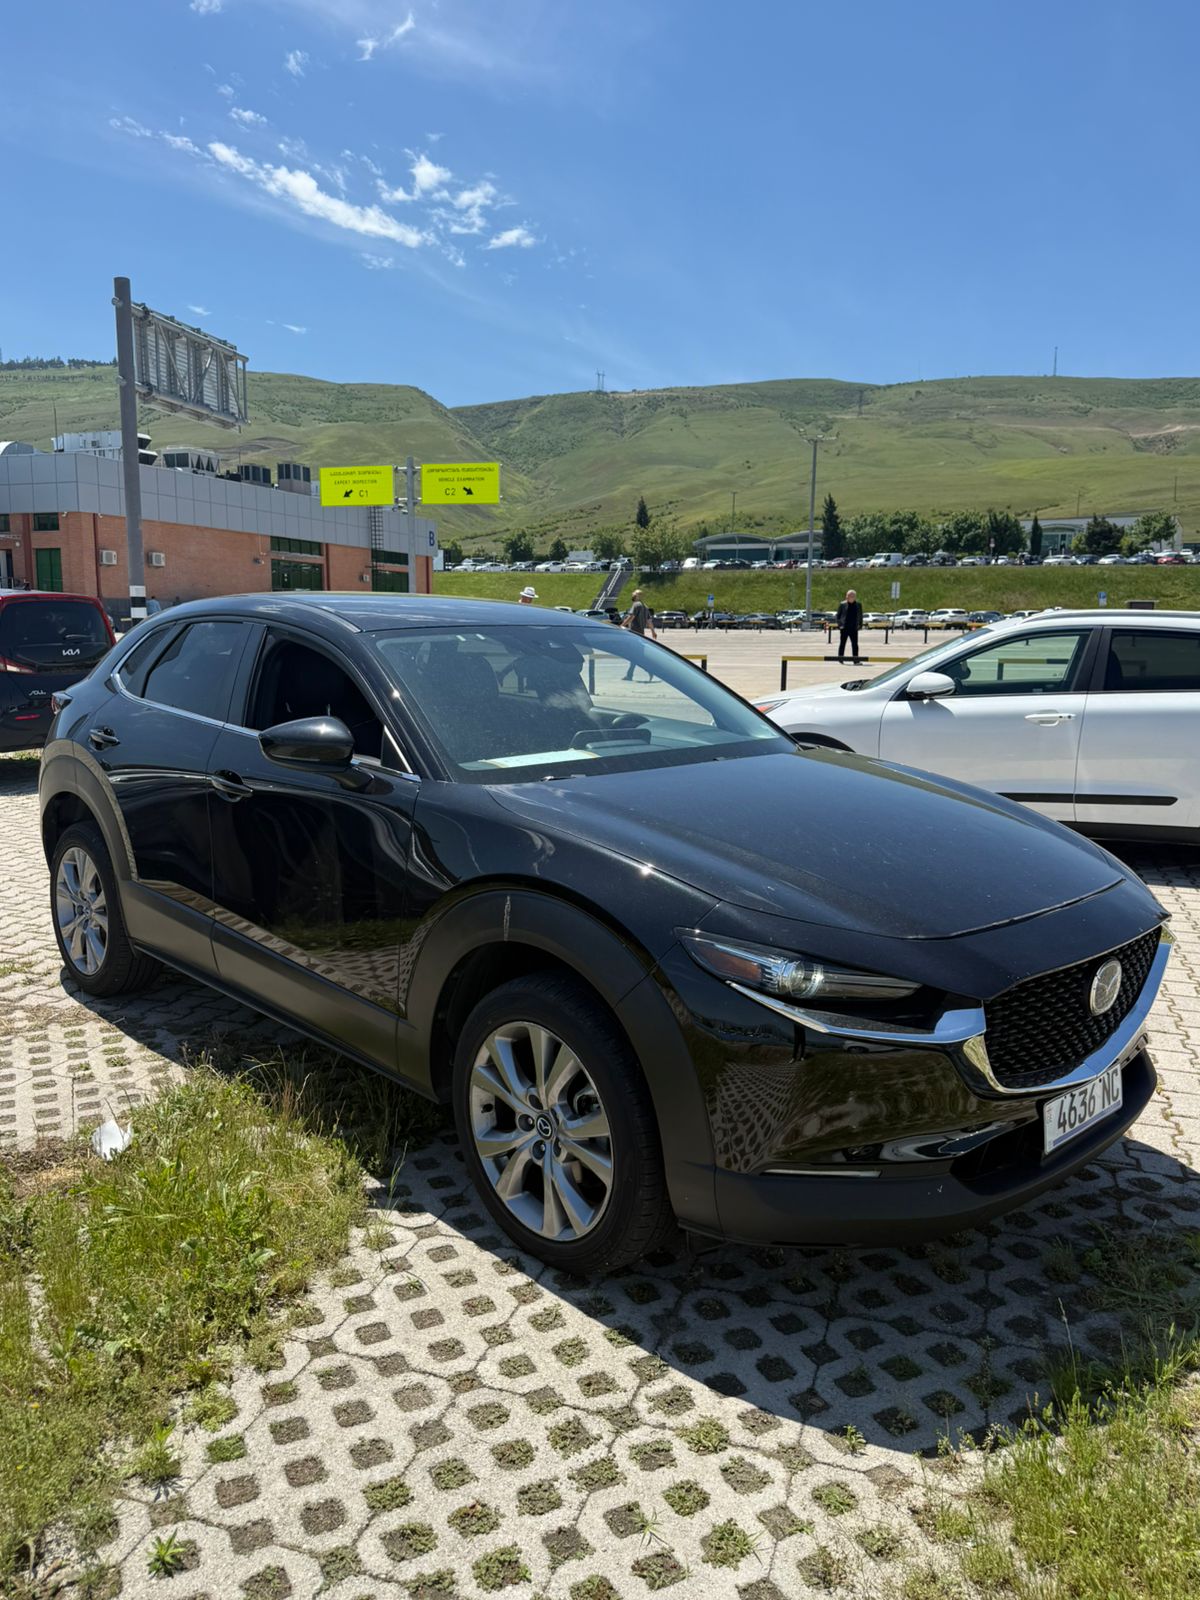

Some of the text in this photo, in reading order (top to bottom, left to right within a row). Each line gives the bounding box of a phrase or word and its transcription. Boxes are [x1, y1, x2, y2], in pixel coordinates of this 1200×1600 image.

[358, 489, 369, 498] C1
[444, 487, 456, 496] C2
[429, 531, 435, 547] B
[1057, 1083, 1096, 1133] 4636
[1102, 1068, 1119, 1109] NC
